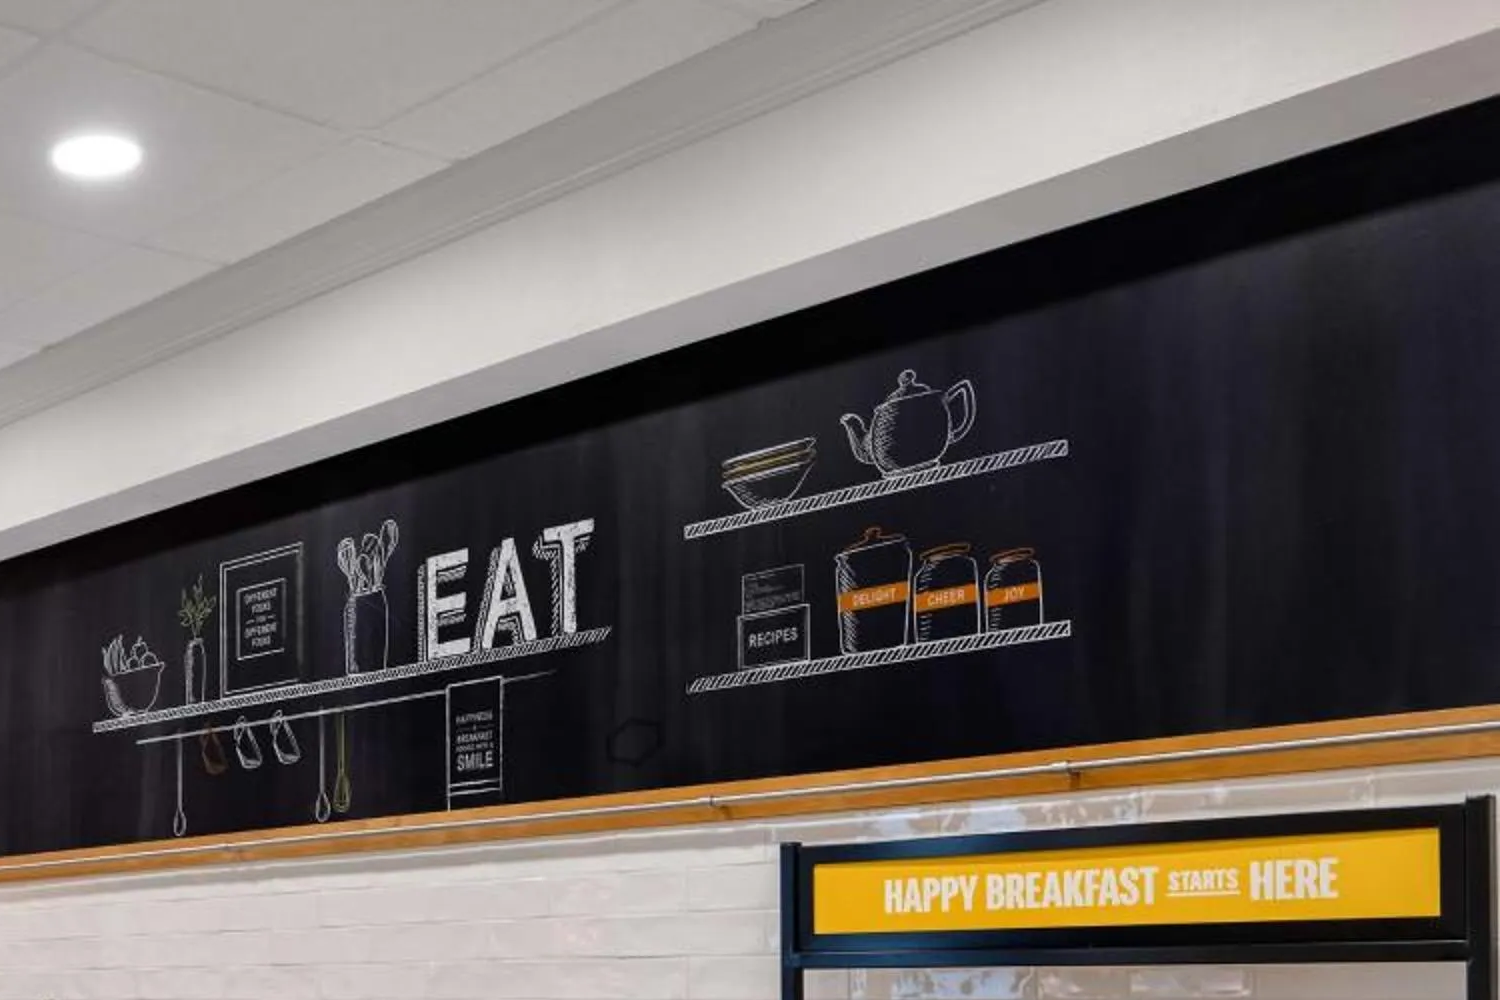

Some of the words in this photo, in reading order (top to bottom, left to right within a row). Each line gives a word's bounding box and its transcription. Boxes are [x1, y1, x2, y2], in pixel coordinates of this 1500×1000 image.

[417, 517, 595, 662] EAT
[852, 587, 897, 607] DELIGHT
[927, 589, 965, 606] CHEER
[1003, 587, 1025, 601] JOY
[748, 627, 799, 648] RECIPES
[457, 750, 493, 771] SMILE
[884, 874, 978, 914] HAPPY
[985, 865, 1159, 911] BREAKFAST
[1167, 868, 1239, 892] STARTS
[1250, 856, 1339, 901] HERE
